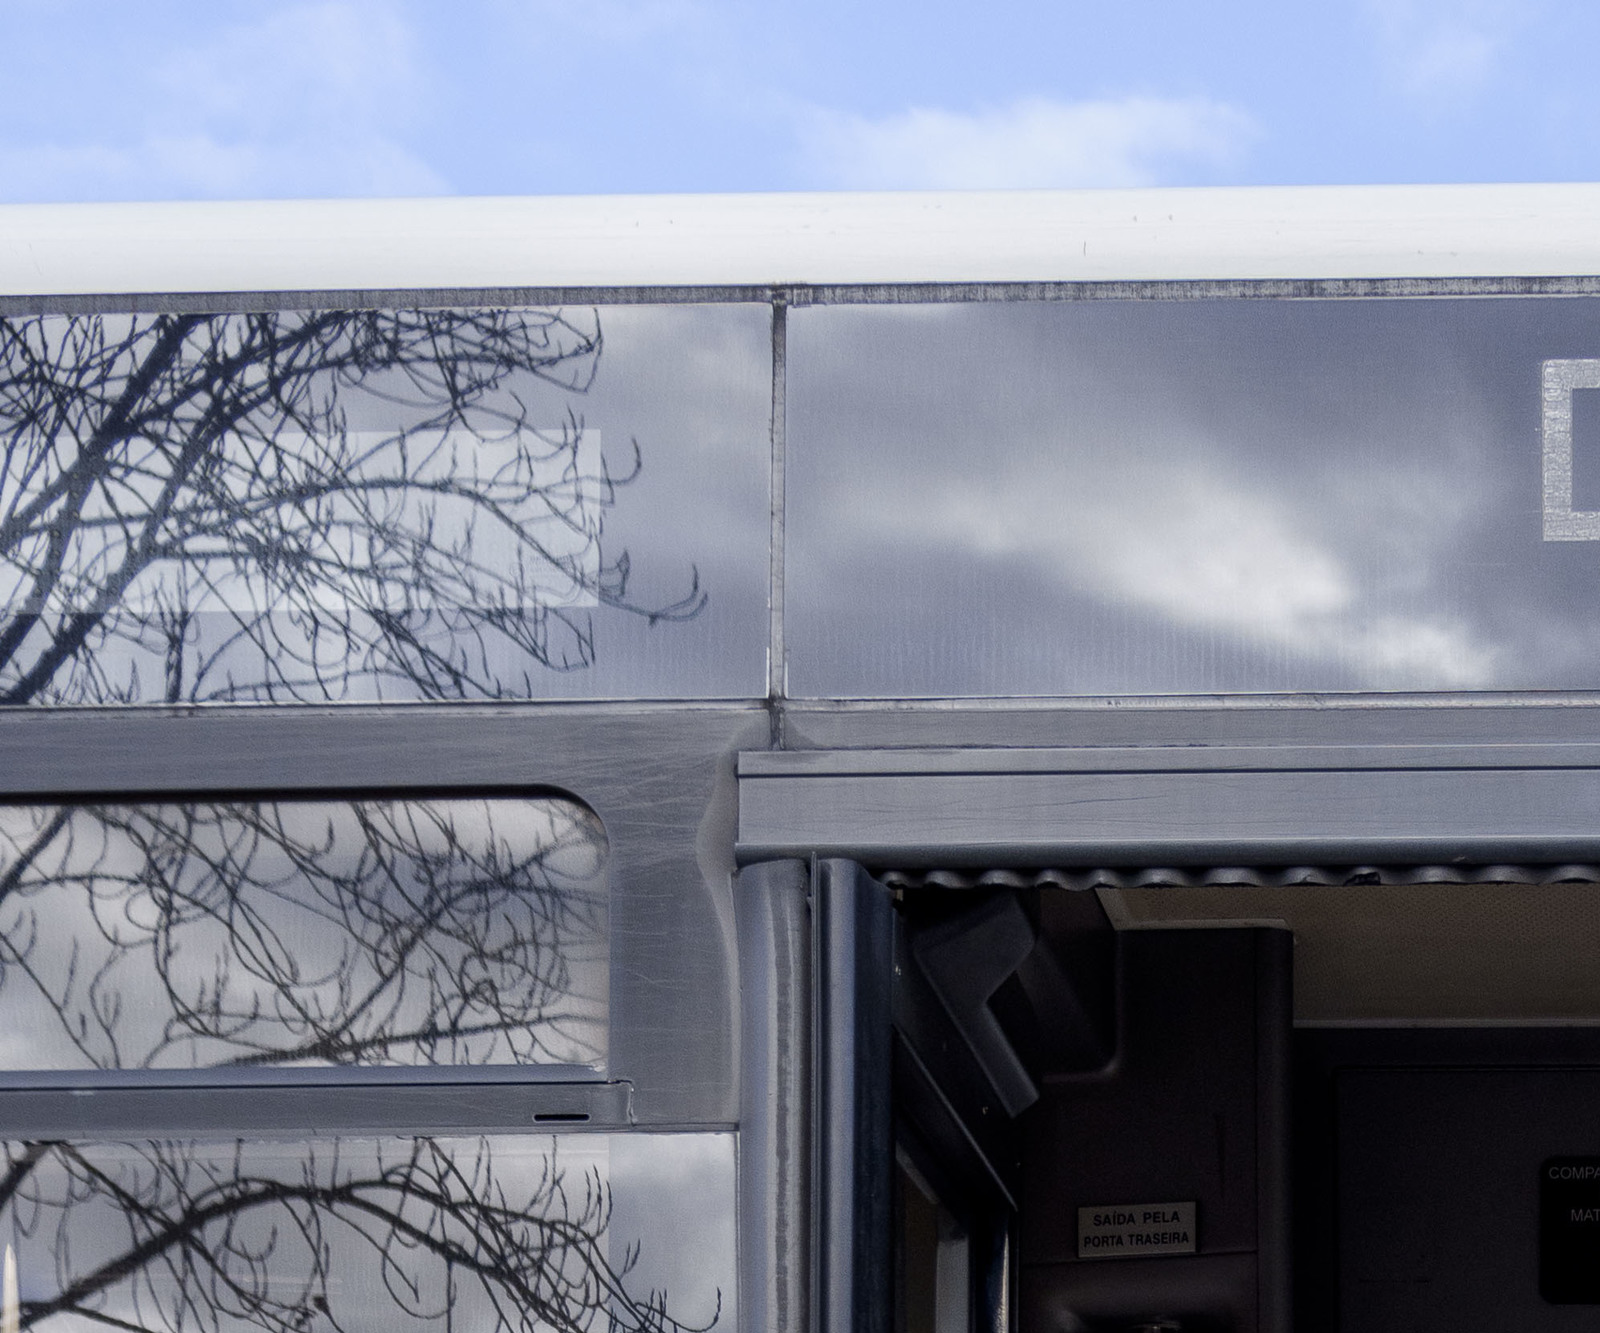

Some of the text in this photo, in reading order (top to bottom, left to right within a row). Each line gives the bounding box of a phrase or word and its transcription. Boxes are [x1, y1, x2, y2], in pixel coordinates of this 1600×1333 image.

[1093, 1210, 1181, 1227] SAÍDA PELA
[1083, 1231, 1189, 1248] PORTA TRASEIRA
